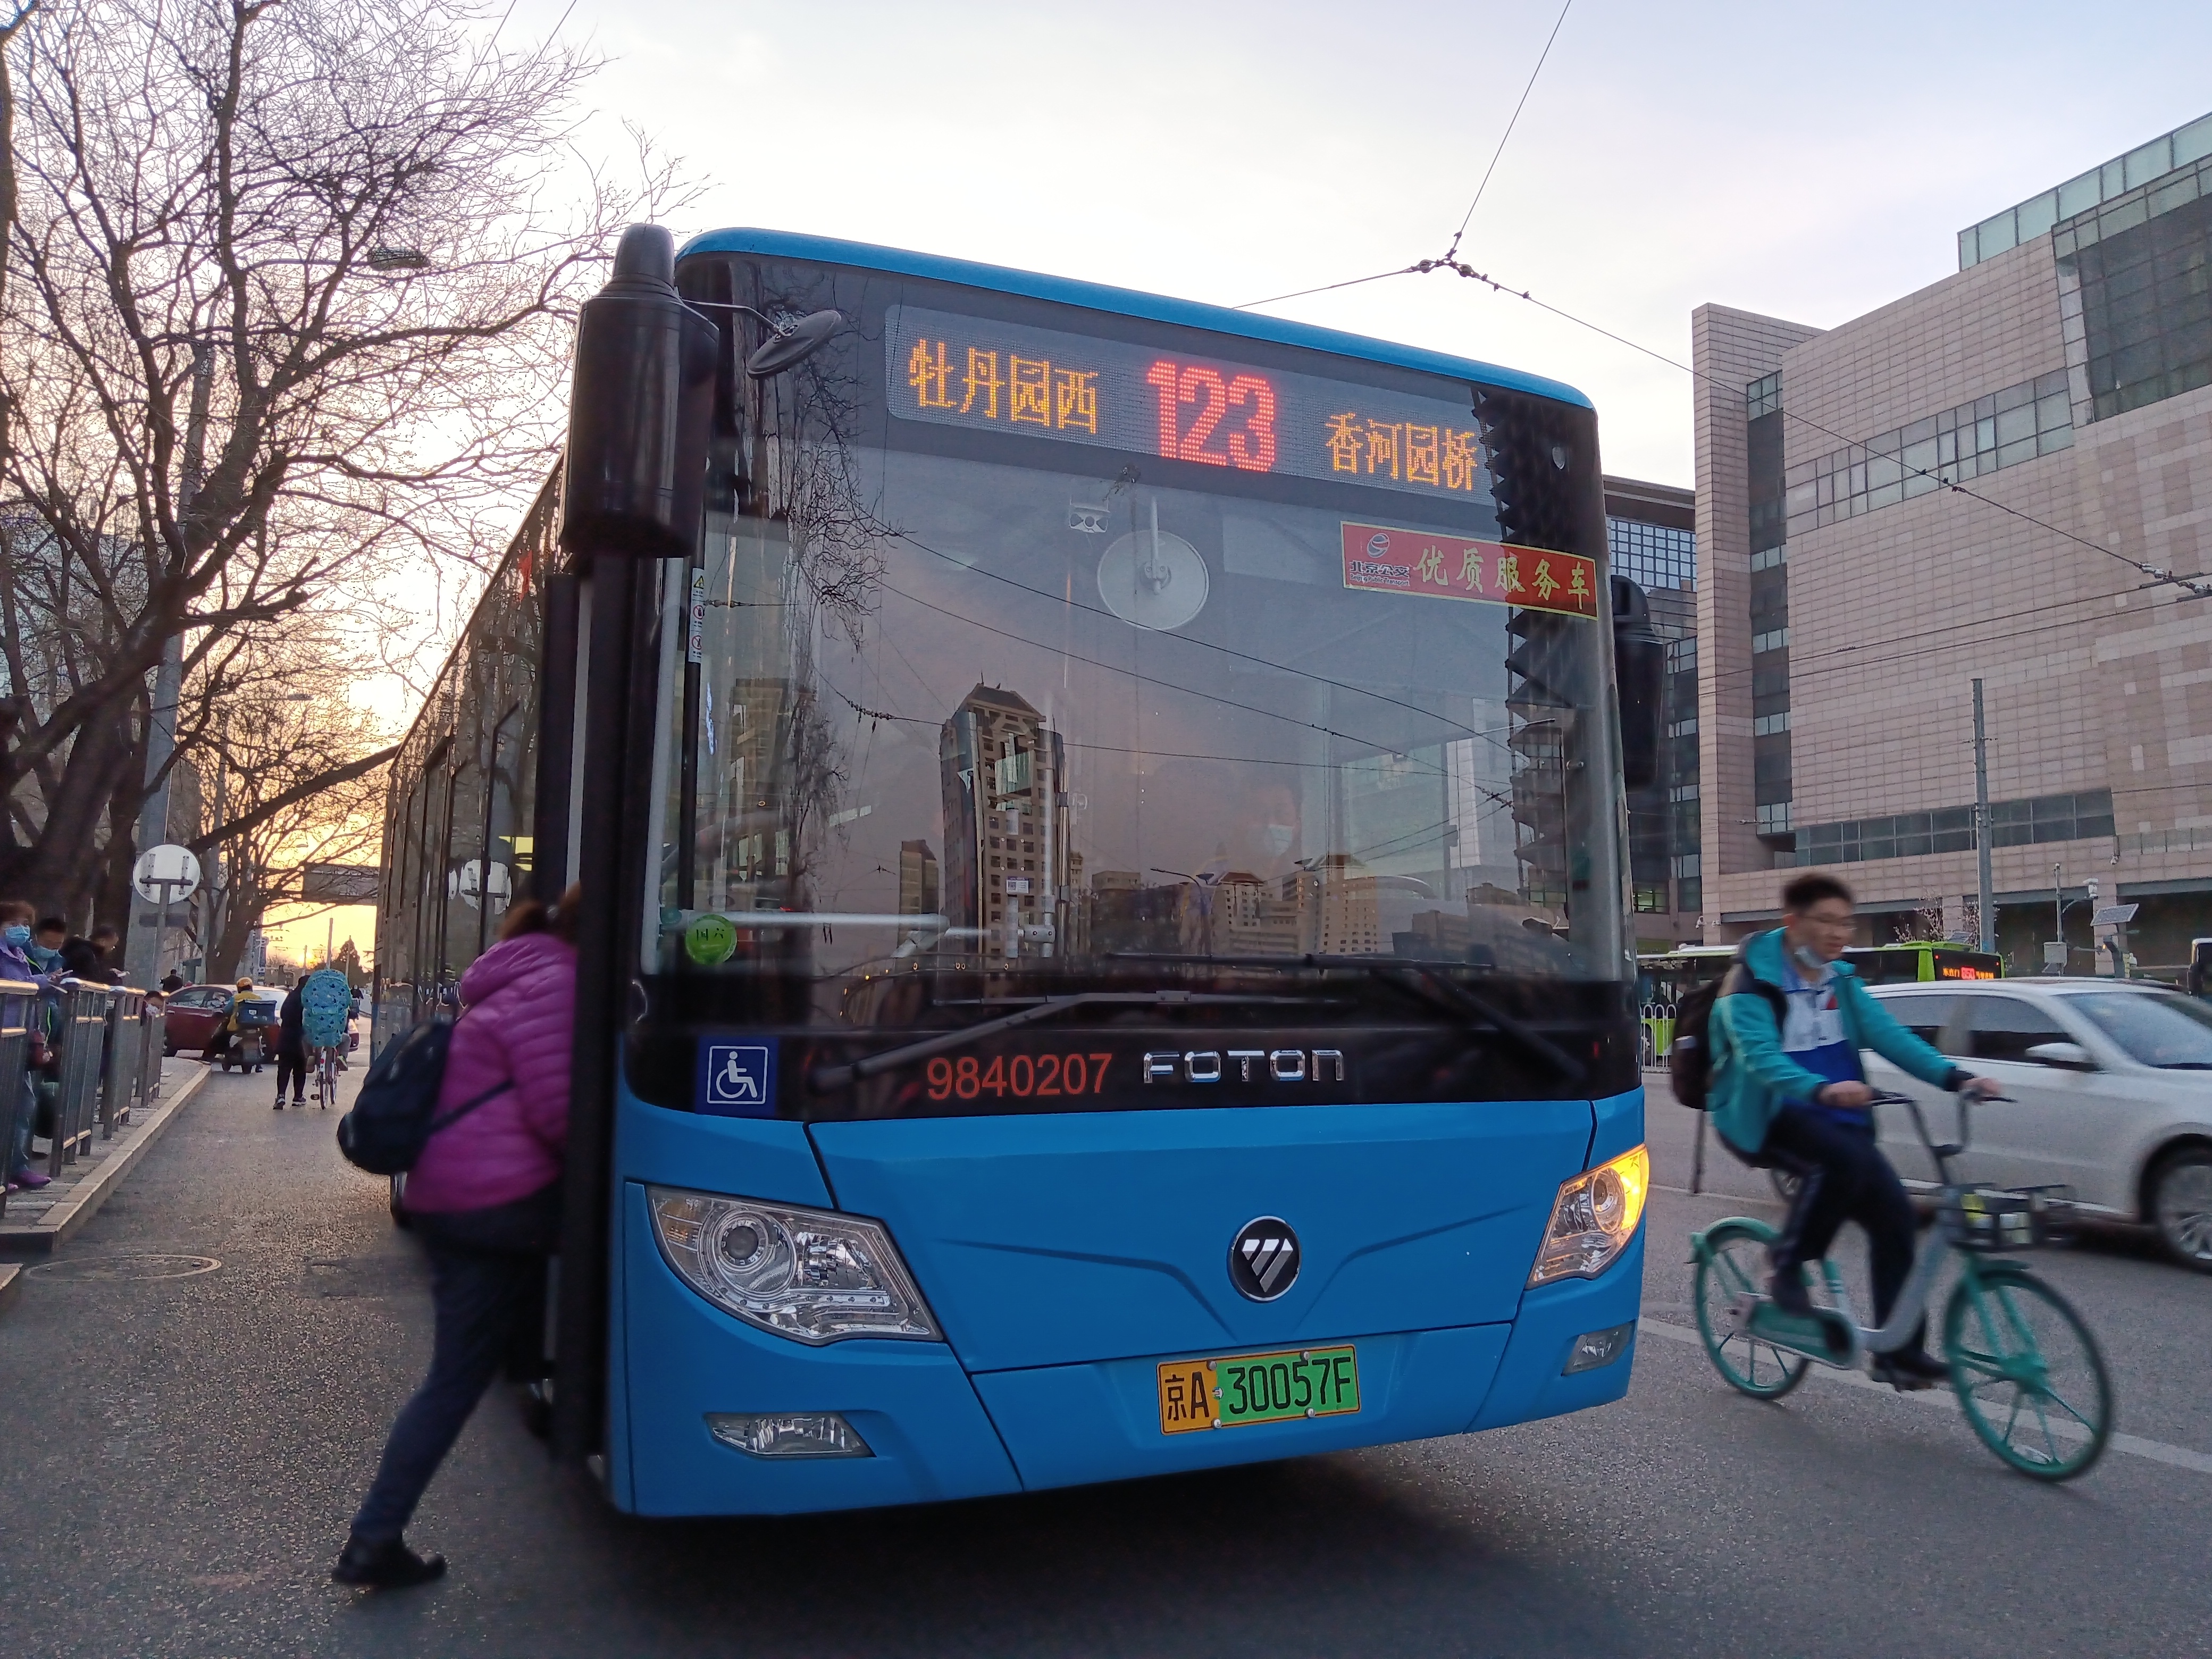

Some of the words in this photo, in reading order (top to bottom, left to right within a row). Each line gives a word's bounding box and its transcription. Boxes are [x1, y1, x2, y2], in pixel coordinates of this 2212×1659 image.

[909, 338, 1099, 435] 牡丹园西
[1146, 361, 1276, 473] 123
[1324, 412, 1478, 491] 香河园桥
[1350, 560, 1410, 578] 北京公交
[1413, 544, 1590, 610] 优质服务车
[927, 1053, 1112, 1100] 9840207
[1143, 1049, 1344, 1084] FOTON
[1164, 1371, 1210, 1421] 京A
[1227, 1356, 1352, 1414] 30057F
